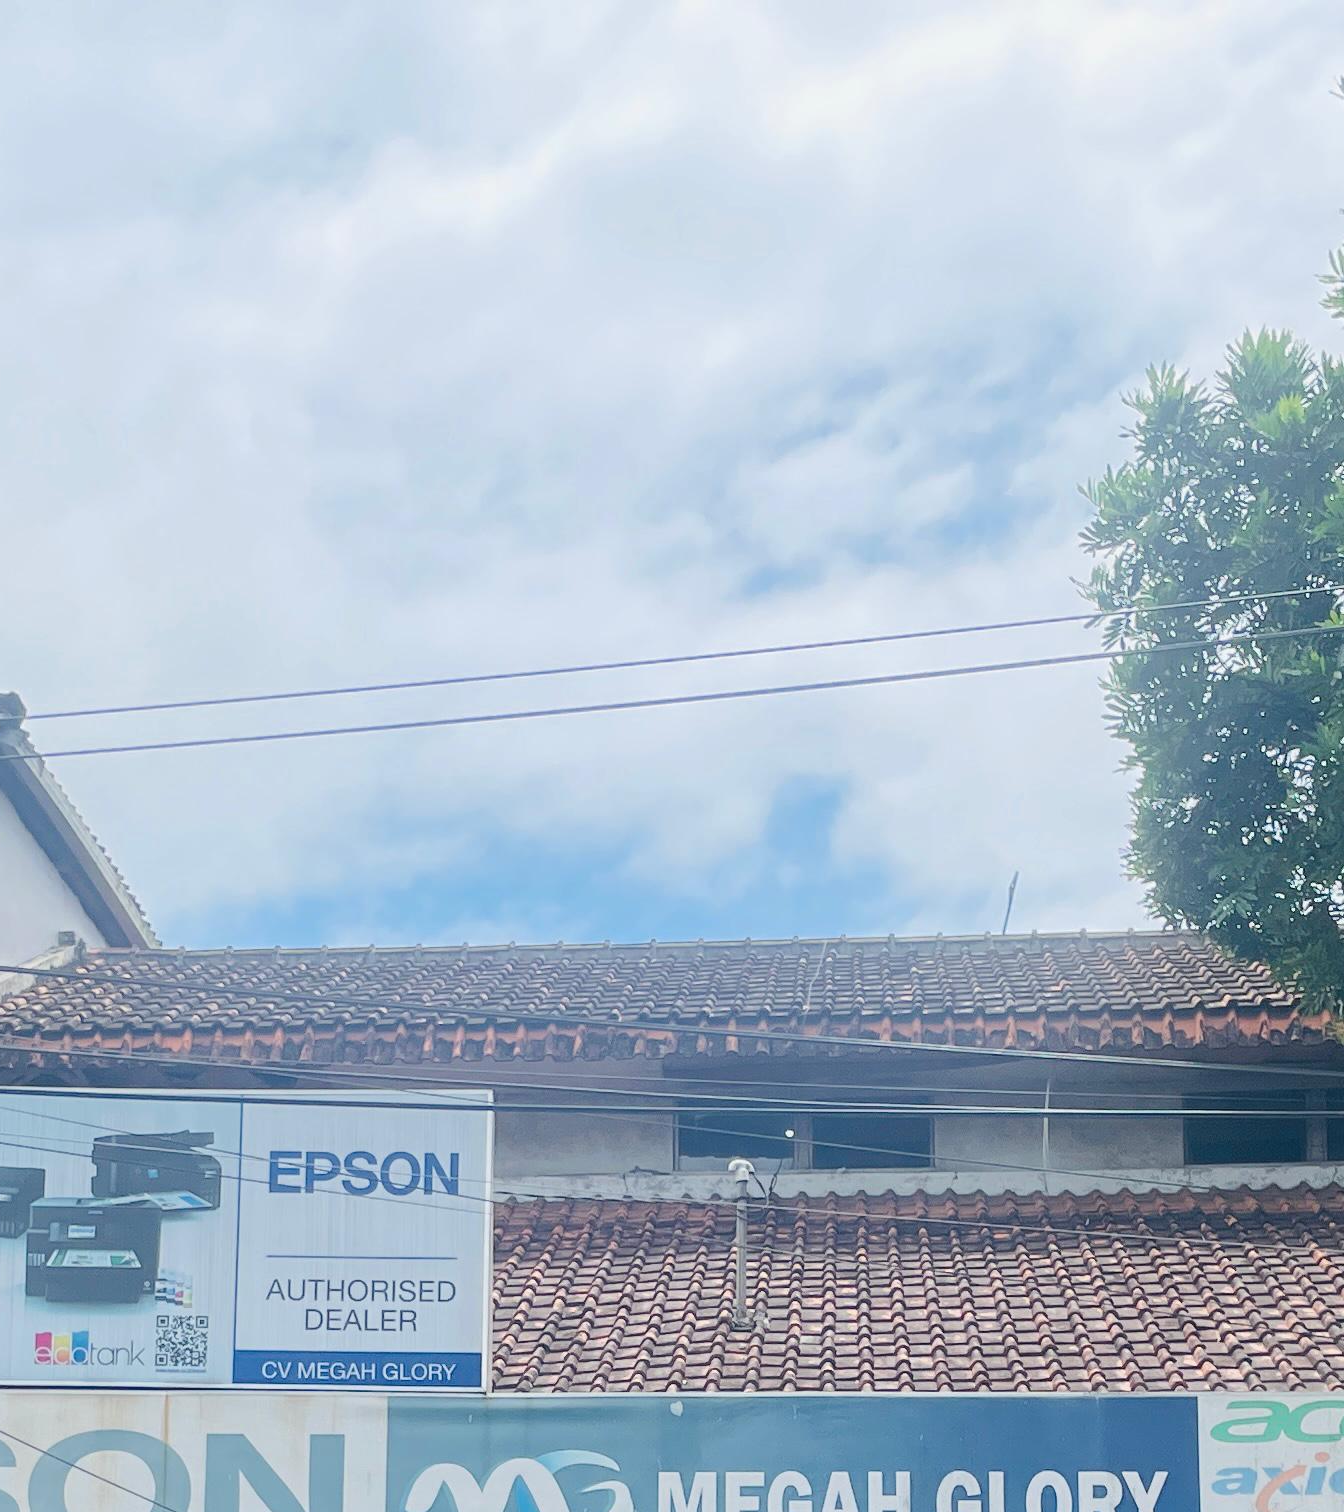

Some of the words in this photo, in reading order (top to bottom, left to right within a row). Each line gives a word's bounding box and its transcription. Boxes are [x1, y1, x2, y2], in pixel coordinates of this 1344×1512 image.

[269, 1151, 460, 1197] EPSON
[266, 1276, 457, 1305] AUTHORISED
[305, 1307, 418, 1333] DEALER
[35, 1339, 144, 1366] ecotank
[262, 1361, 293, 1381] CV
[299, 1361, 378, 1382] MEGAH
[384, 1361, 457, 1383] GLORY
